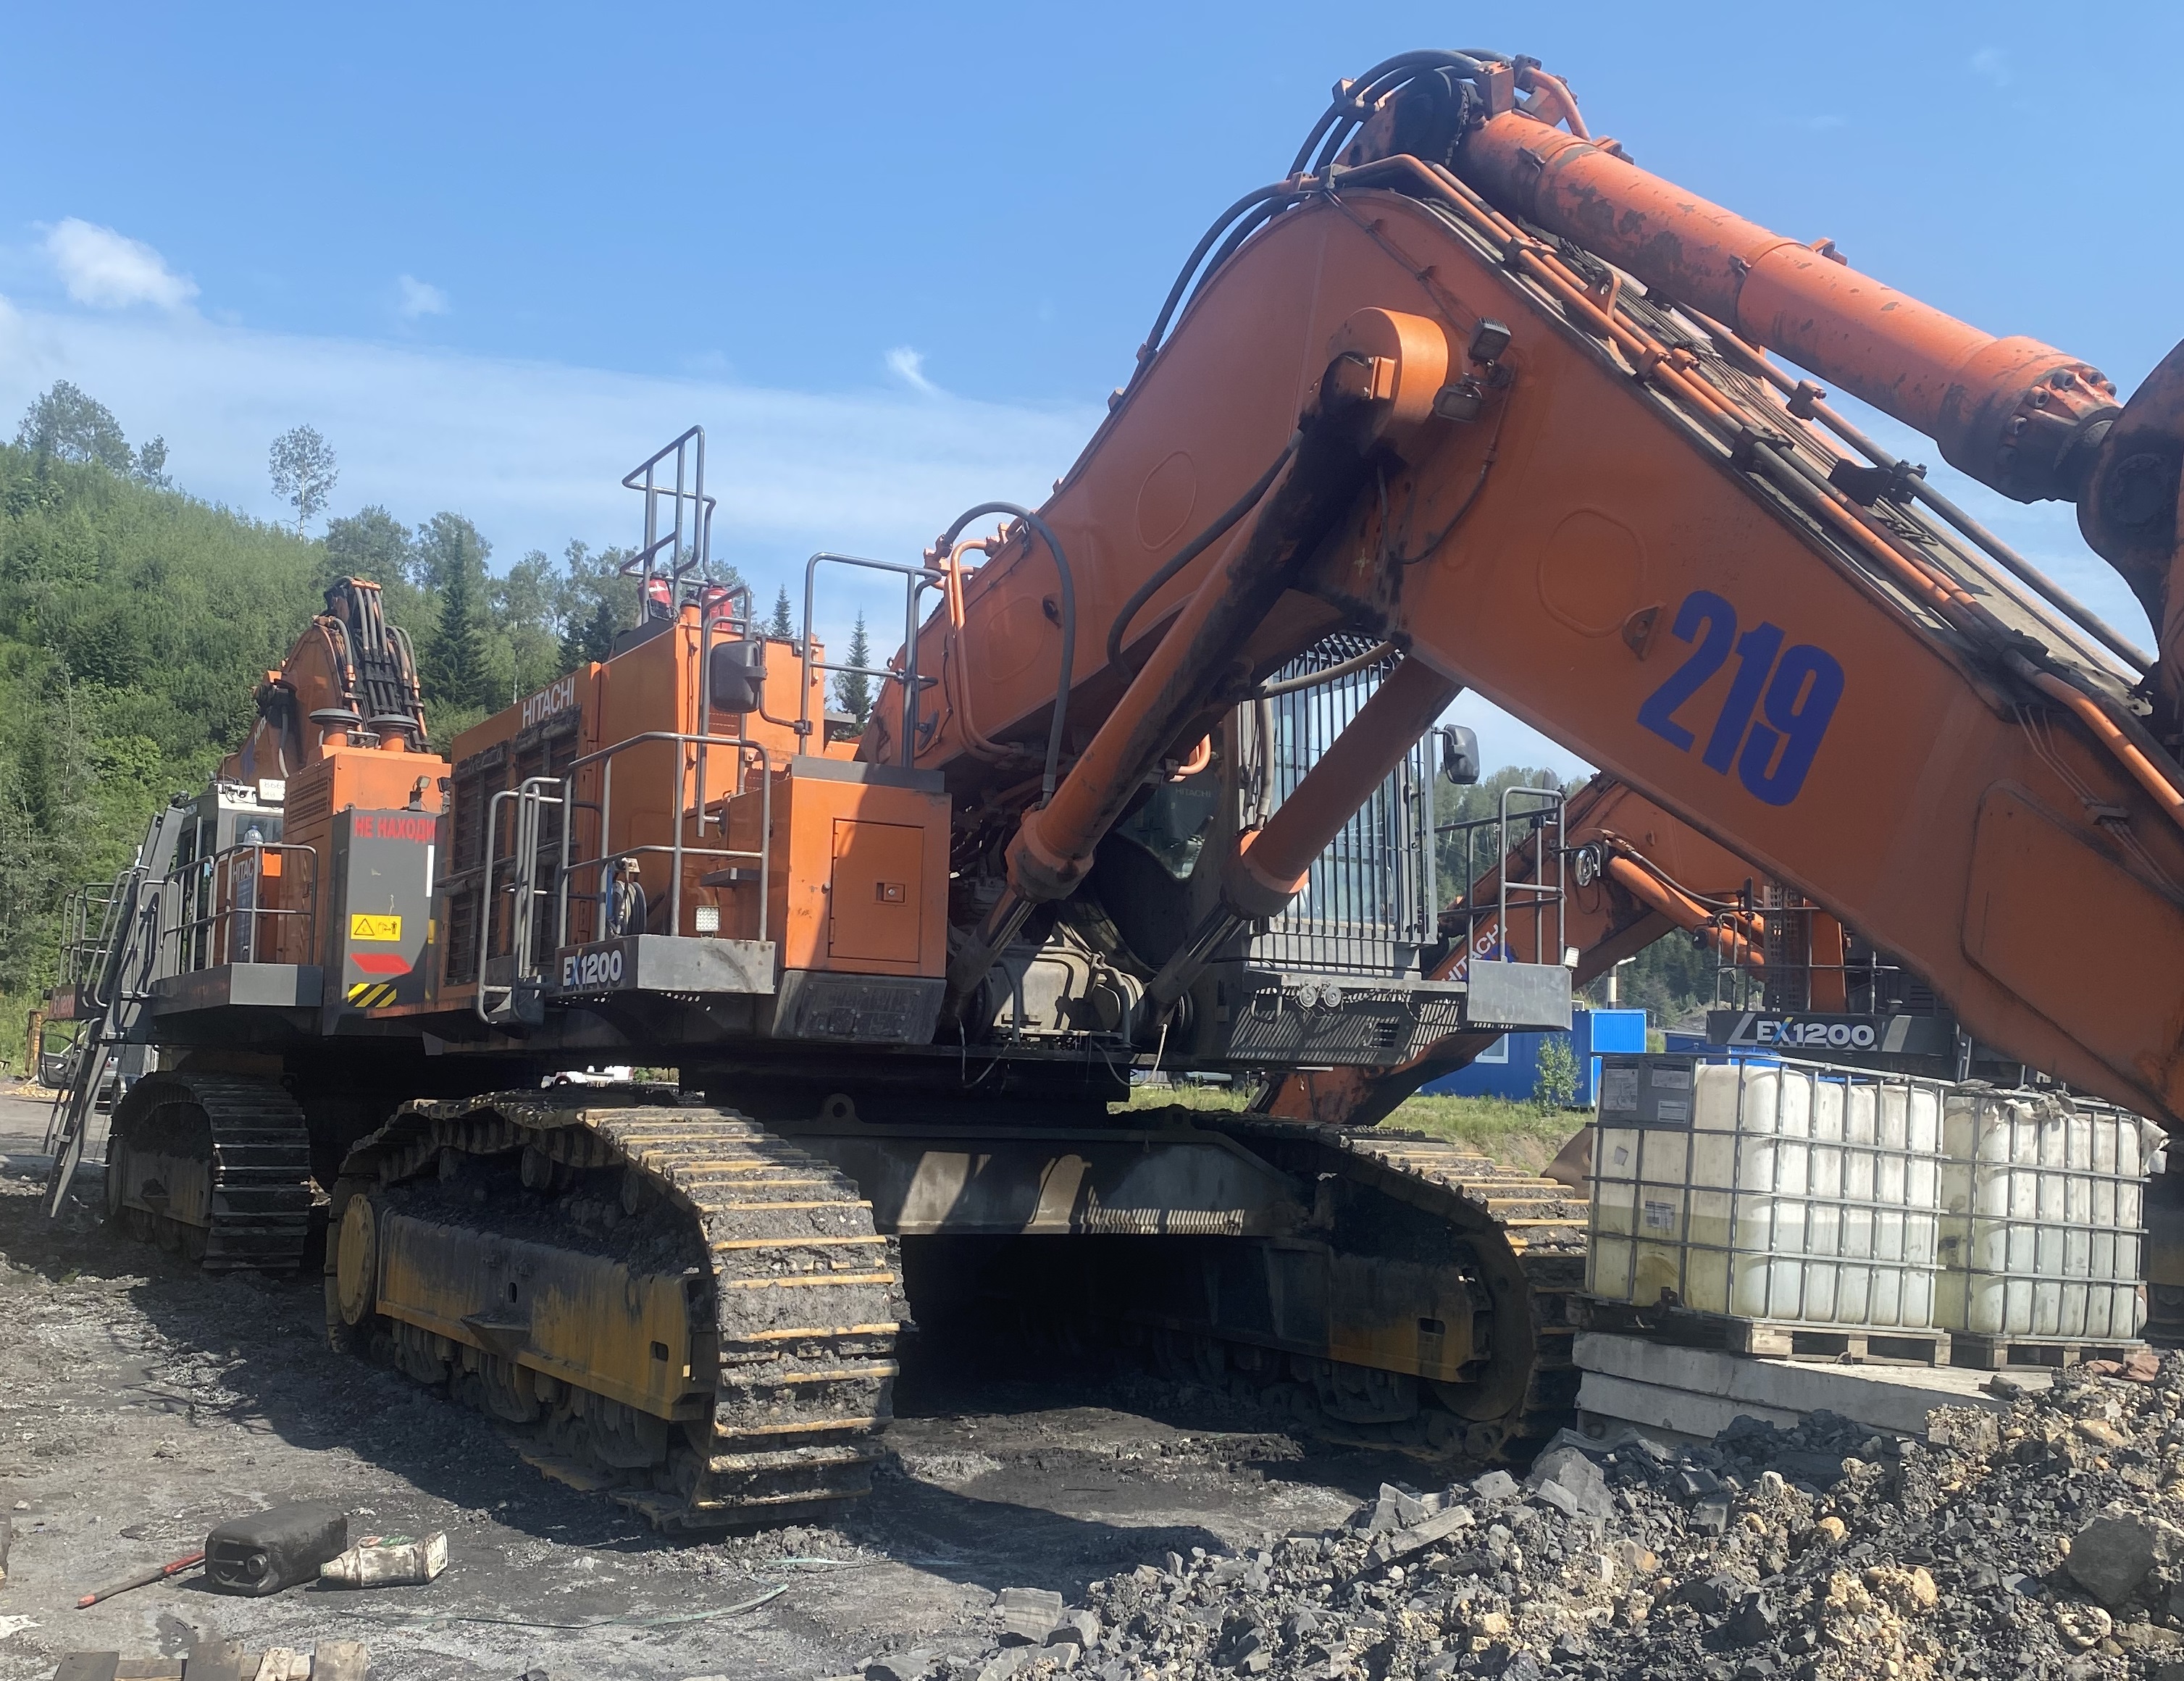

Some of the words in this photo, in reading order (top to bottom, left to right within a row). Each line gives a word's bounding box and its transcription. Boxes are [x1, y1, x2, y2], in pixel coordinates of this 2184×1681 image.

[522, 676, 575, 729] HITACHI
[1636, 590, 1845, 807] 219
[1175, 787, 1211, 797] HITACHI
[354, 816, 374, 838] НЕ
[563, 947, 622, 986] EX1200
[1757, 1016, 1875, 1046] EX1200
